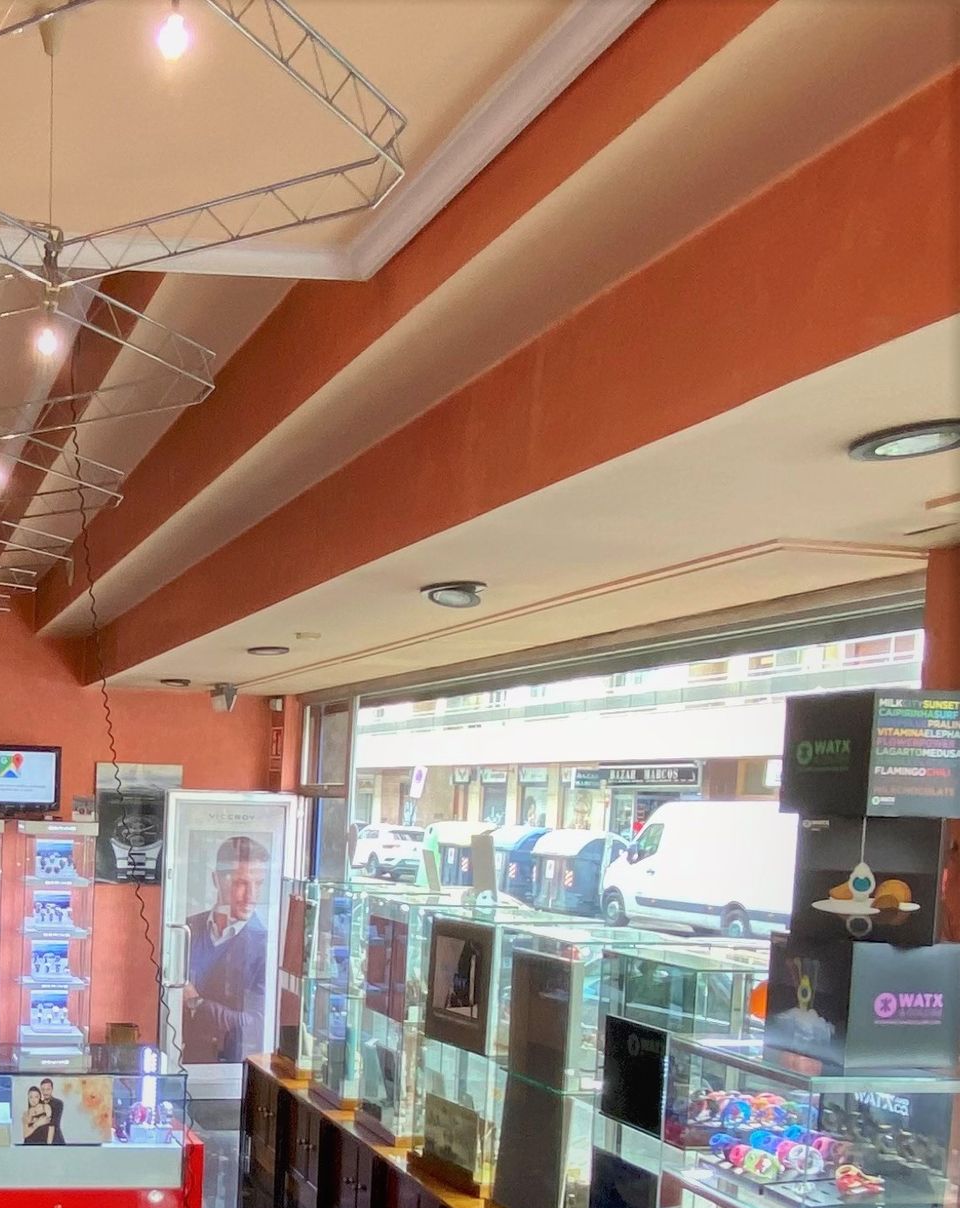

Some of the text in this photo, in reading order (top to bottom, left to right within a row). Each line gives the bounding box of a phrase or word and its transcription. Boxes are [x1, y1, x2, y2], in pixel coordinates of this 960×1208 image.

[814, 739, 851, 755] WATX
[208, 813, 256, 821] VICEROY
[898, 993, 944, 1008] WATX
